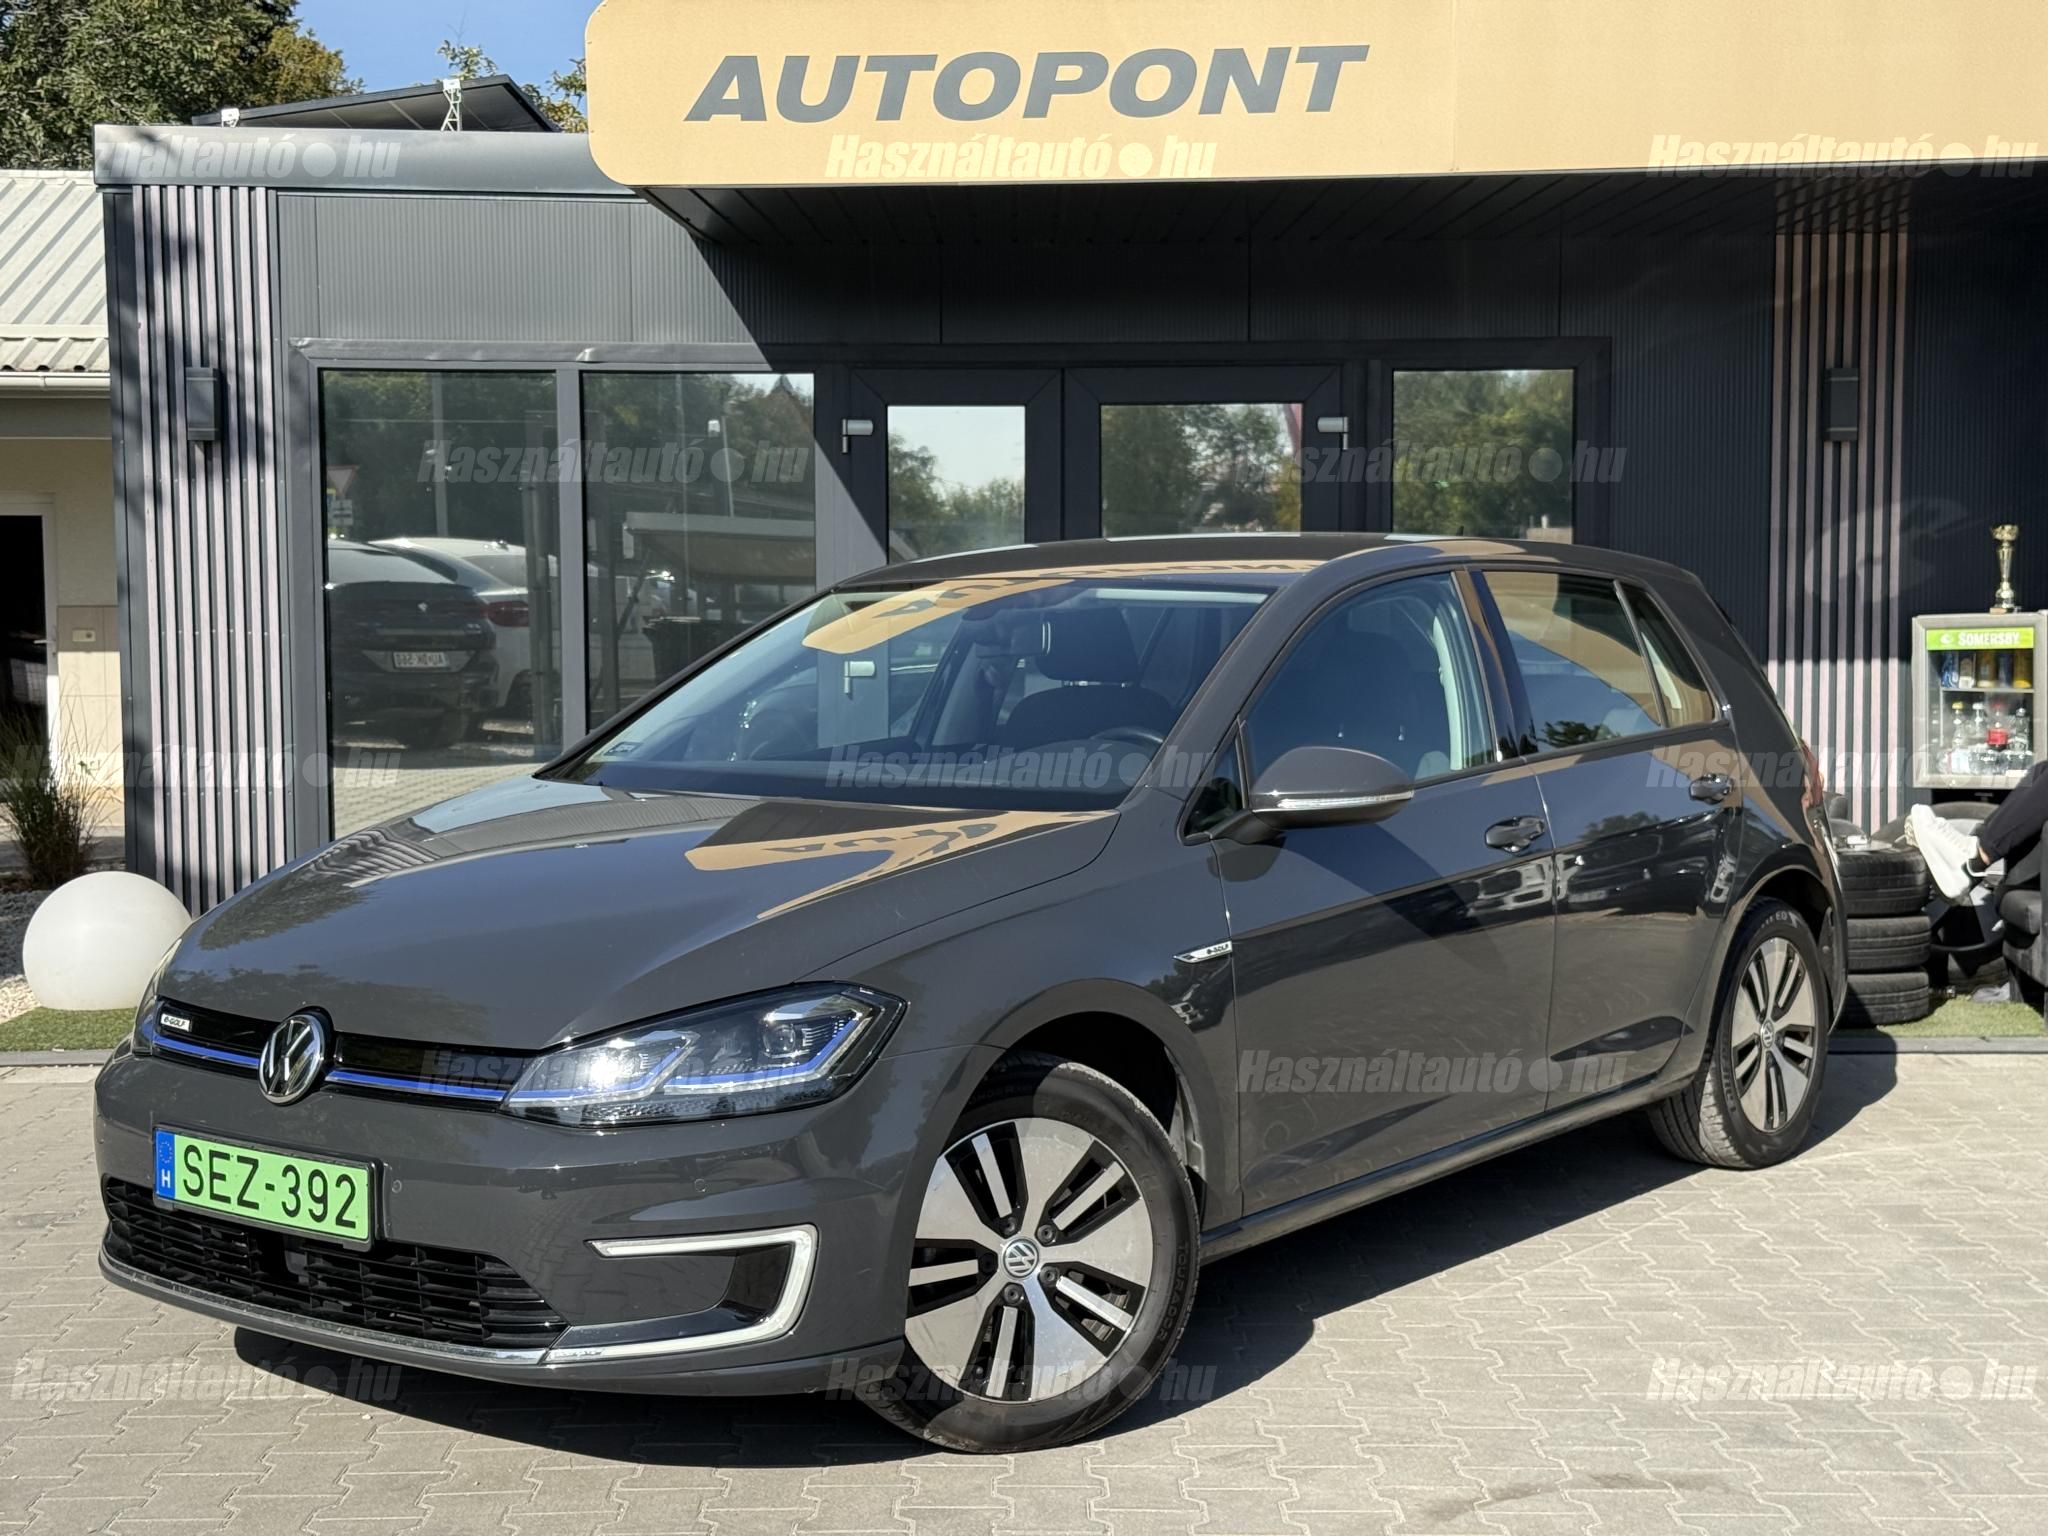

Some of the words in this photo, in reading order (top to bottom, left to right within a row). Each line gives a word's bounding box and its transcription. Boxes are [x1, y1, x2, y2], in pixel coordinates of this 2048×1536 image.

[683, 45, 1369, 122] AUTOPONT
[1958, 631, 2020, 646] SOMERSBY
[161, 1170, 171, 1188] H
[183, 1144, 358, 1229] SEZ-392
[1158, 1242, 1189, 1342] TOURADOR
